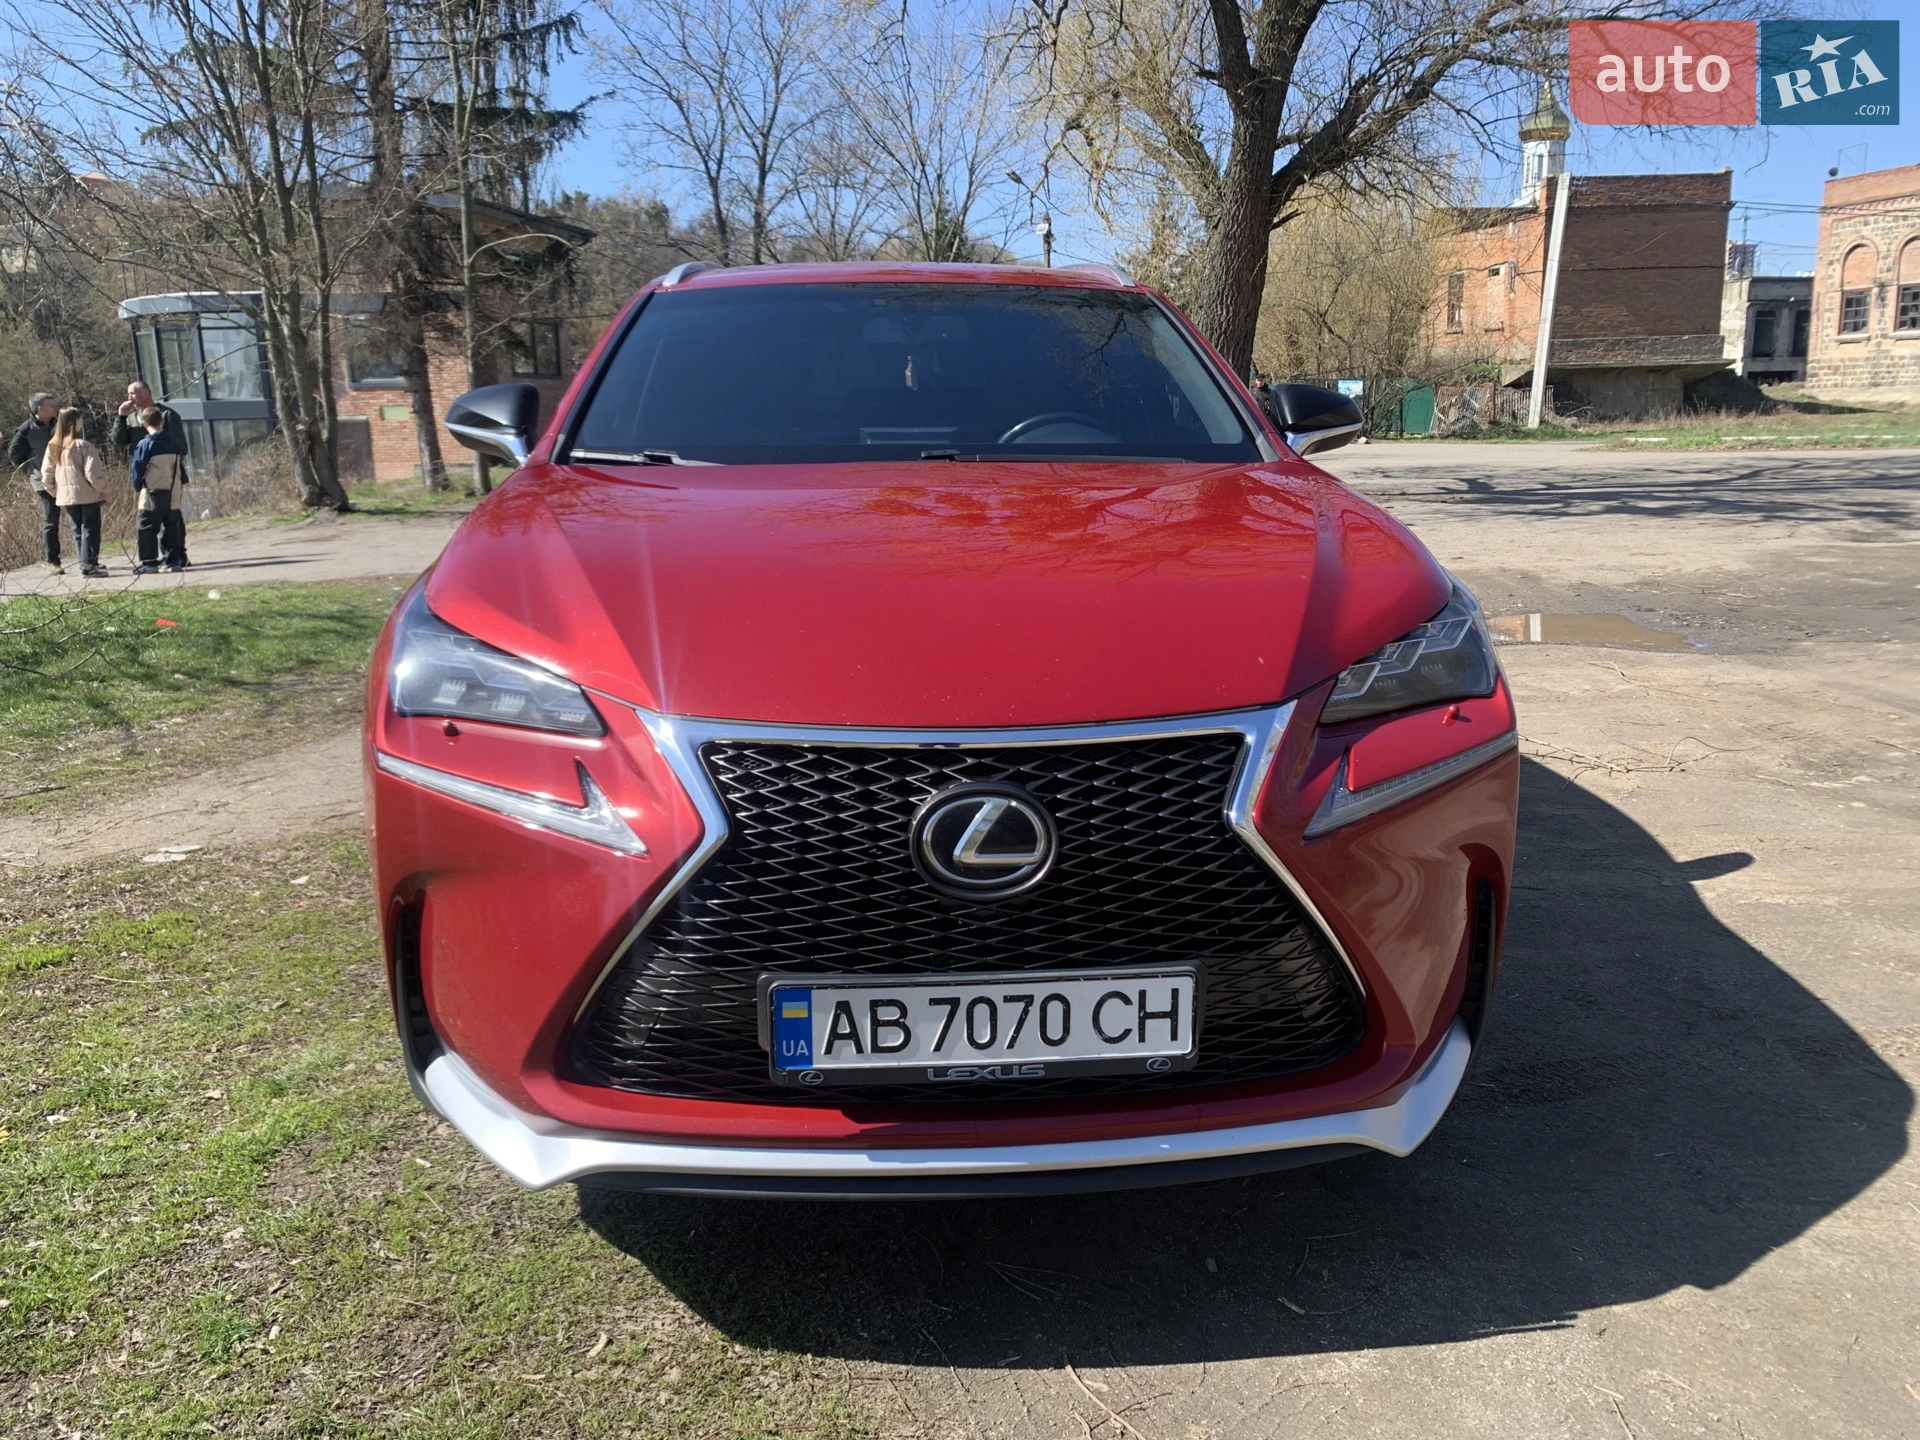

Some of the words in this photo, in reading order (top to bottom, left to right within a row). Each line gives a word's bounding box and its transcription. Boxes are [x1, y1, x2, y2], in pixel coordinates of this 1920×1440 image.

[823, 999, 912, 1056] AB
[928, 993, 1071, 1053] 7070
[1091, 987, 1180, 1045] CH
[782, 1039, 809, 1057] UA
[927, 1064, 1045, 1081] LEXUS
